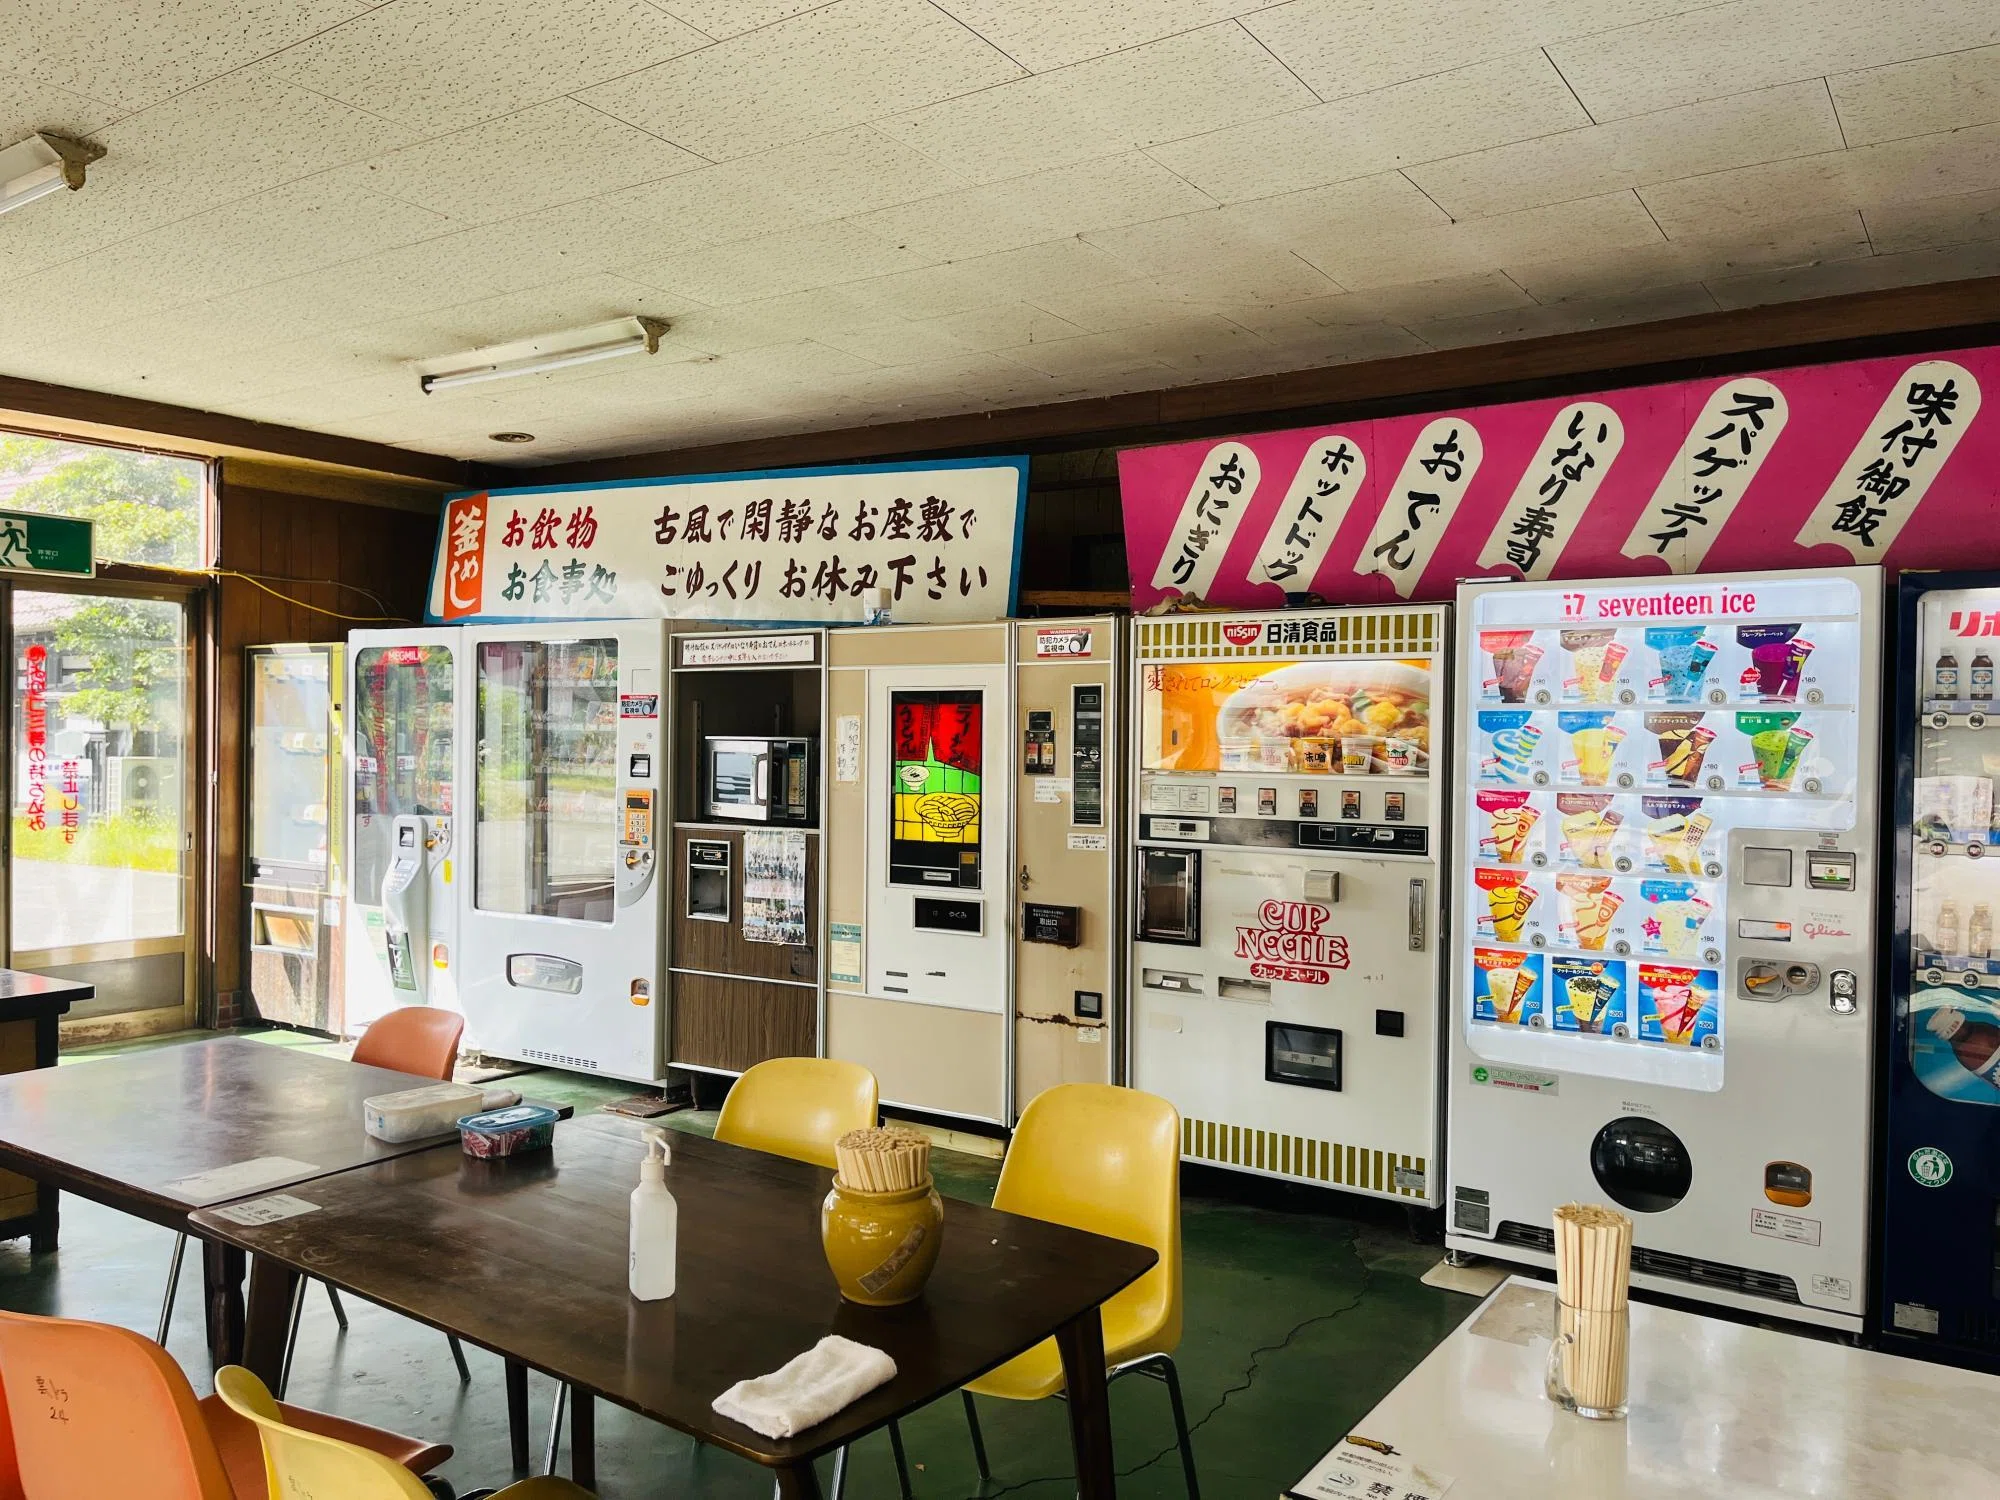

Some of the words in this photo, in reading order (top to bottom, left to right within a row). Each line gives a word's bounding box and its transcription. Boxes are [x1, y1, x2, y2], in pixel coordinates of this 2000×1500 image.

[1649, 392, 1774, 553] スパゲッティ
[1831, 379, 1959, 547] 味付御飯
[1267, 443, 1355, 582] ホットドッグ
[1374, 429, 1465, 570] おでん
[1506, 410, 1608, 572] いなり寿司
[501, 505, 598, 550] お飲物
[1172, 452, 1246, 585] おにぎり
[449, 506, 484, 611] 釜めし
[501, 557, 618, 604] お食事処
[661, 559, 762, 600] ごゆっくり
[779, 554, 988, 601] お休み下さい
[1599, 593, 1713, 618] seventeen
[1721, 586, 1756, 614] ice
[1039, 636, 1069, 645] 防犯カメラ
[1043, 645, 1065, 653] 監視中
[1266, 621, 1337, 644] 日清食品
[1258, 899, 1331, 933] CUP
[1234, 926, 1350, 970] NOODLE
[1254, 963, 1327, 984] カップヌードル
